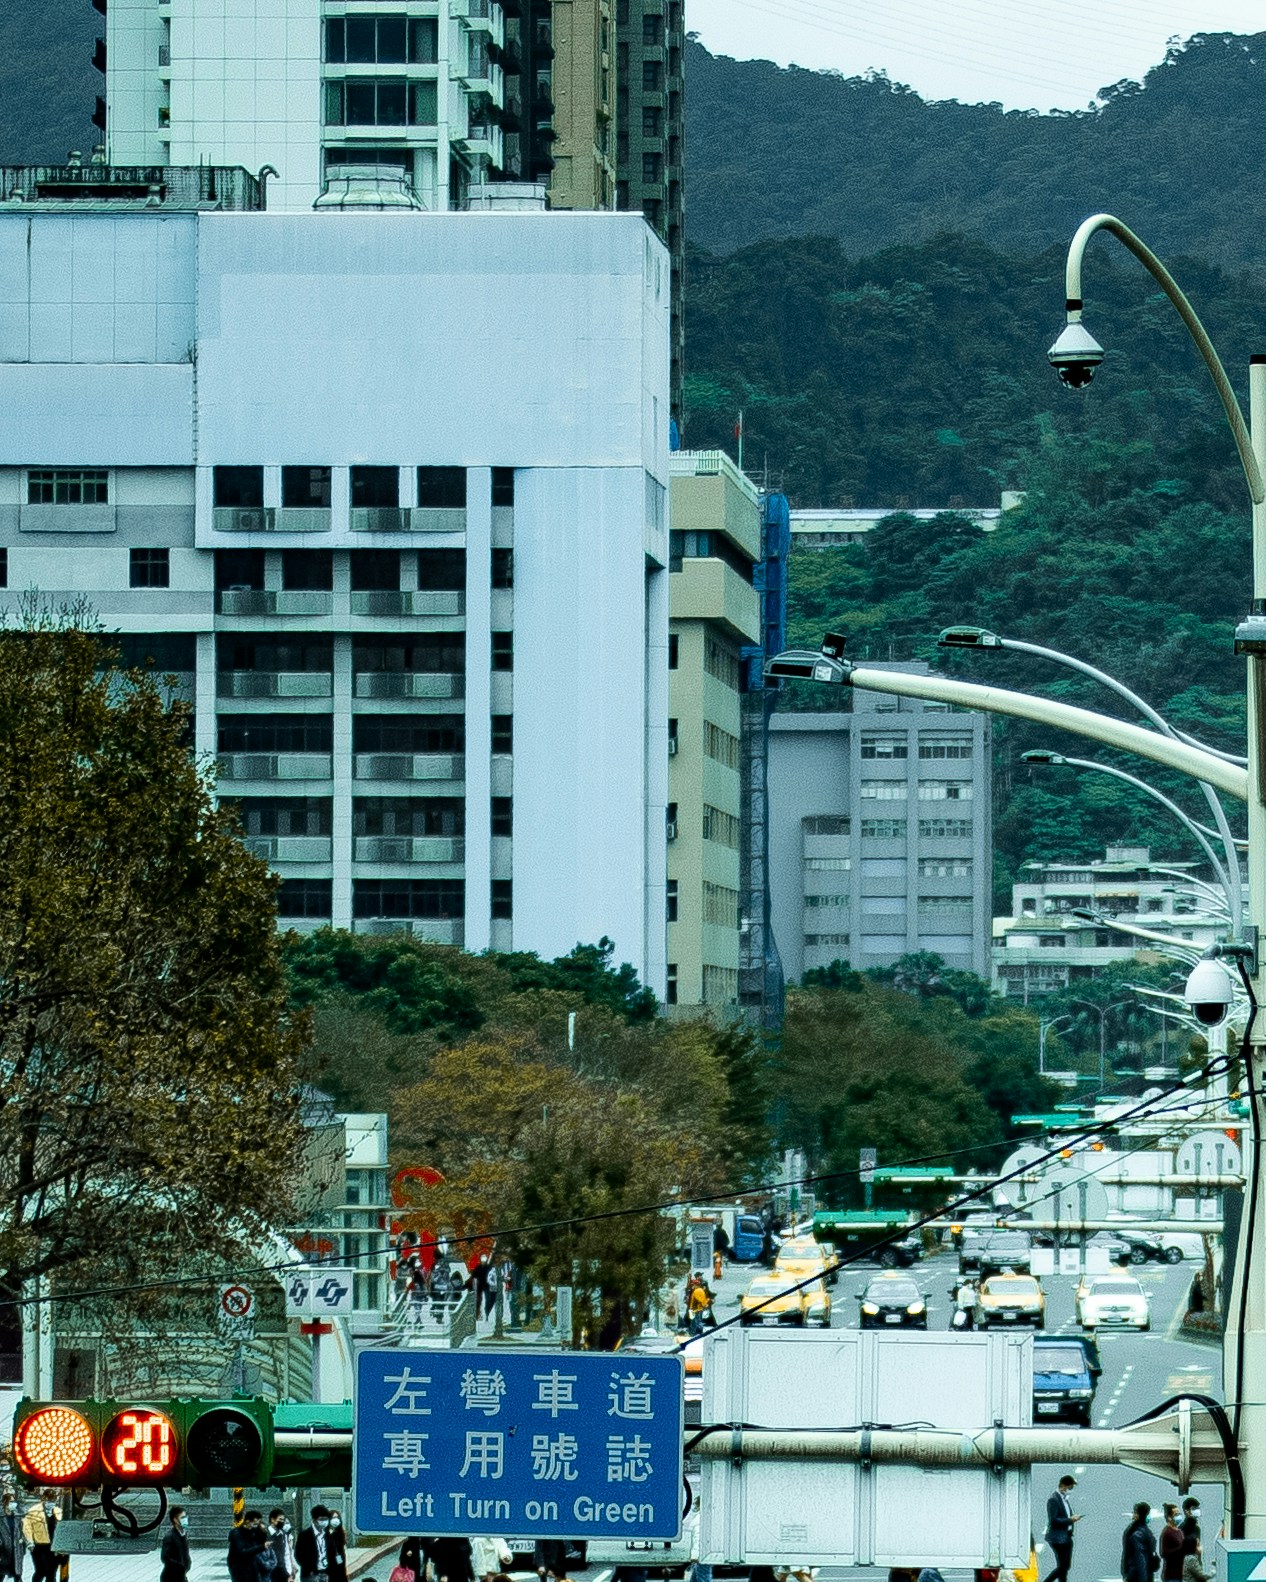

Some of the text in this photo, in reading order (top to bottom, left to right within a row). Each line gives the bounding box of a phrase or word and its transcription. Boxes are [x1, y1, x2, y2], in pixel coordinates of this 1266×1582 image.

[383, 1366, 656, 1420] 左彎車道
[116, 1415, 170, 1472] 20
[382, 1429, 654, 1483] 專用號誌
[381, 1491, 654, 1523] Left Turn on Green
